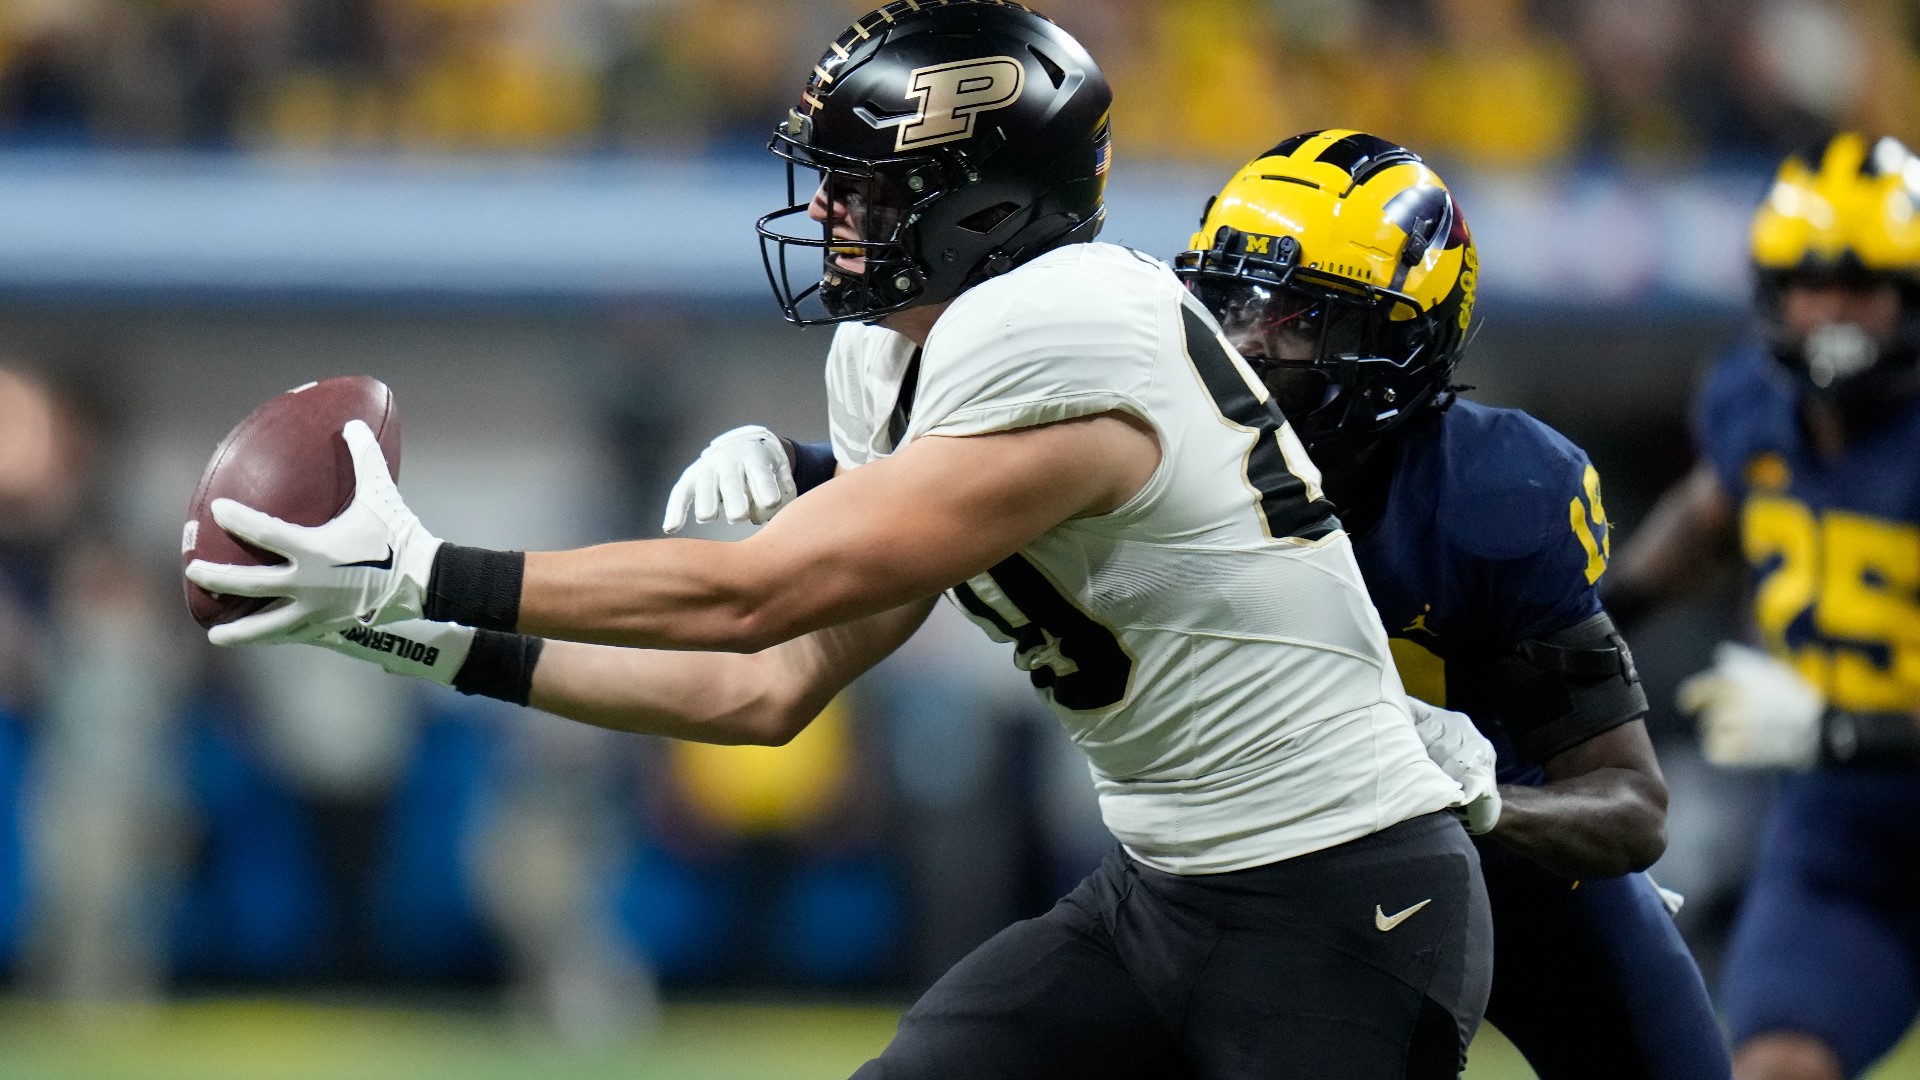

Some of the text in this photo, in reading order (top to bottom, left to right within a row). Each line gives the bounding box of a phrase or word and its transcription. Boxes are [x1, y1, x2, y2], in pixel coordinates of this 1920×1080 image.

[894, 55, 1025, 152] P
[1246, 234, 1270, 254] M
[1320, 261, 1371, 279] JORDAN
[1740, 496, 1920, 713] 25
